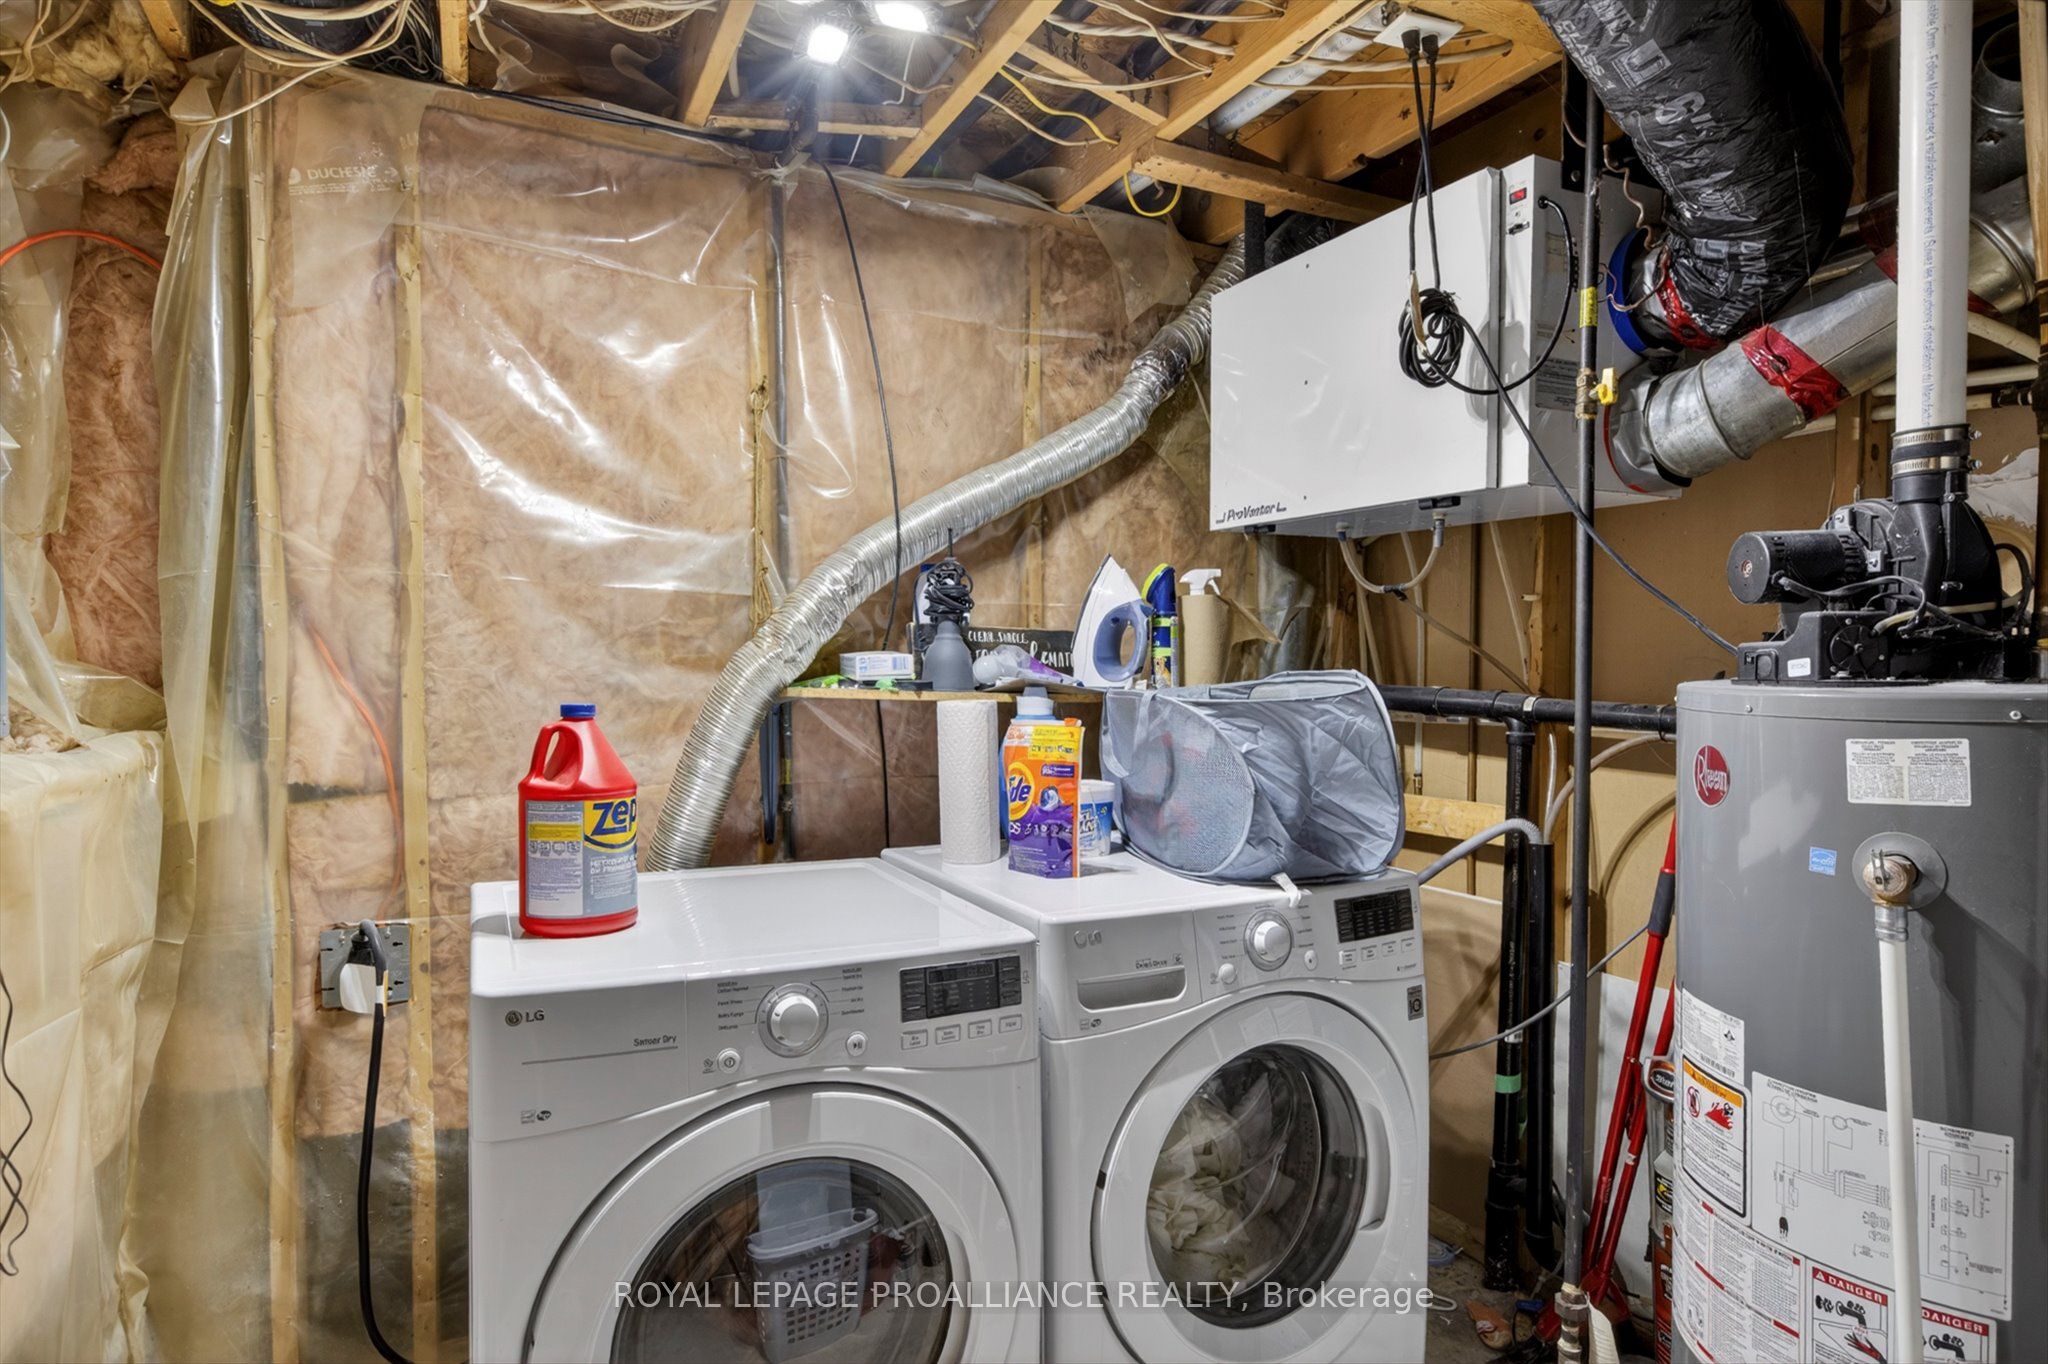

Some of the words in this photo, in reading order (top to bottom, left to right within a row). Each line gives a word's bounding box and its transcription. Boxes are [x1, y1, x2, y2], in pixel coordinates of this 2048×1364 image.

[1697, 745, 1728, 796] Rheem
[1009, 776, 1032, 803] ide
[591, 798, 637, 836] Zep
[526, 1010, 545, 1022] LG
[662, 1034, 677, 1045] Dry
[1828, 1276, 1883, 1304] DANGER
[1921, 1310, 1983, 1334] DANGER
